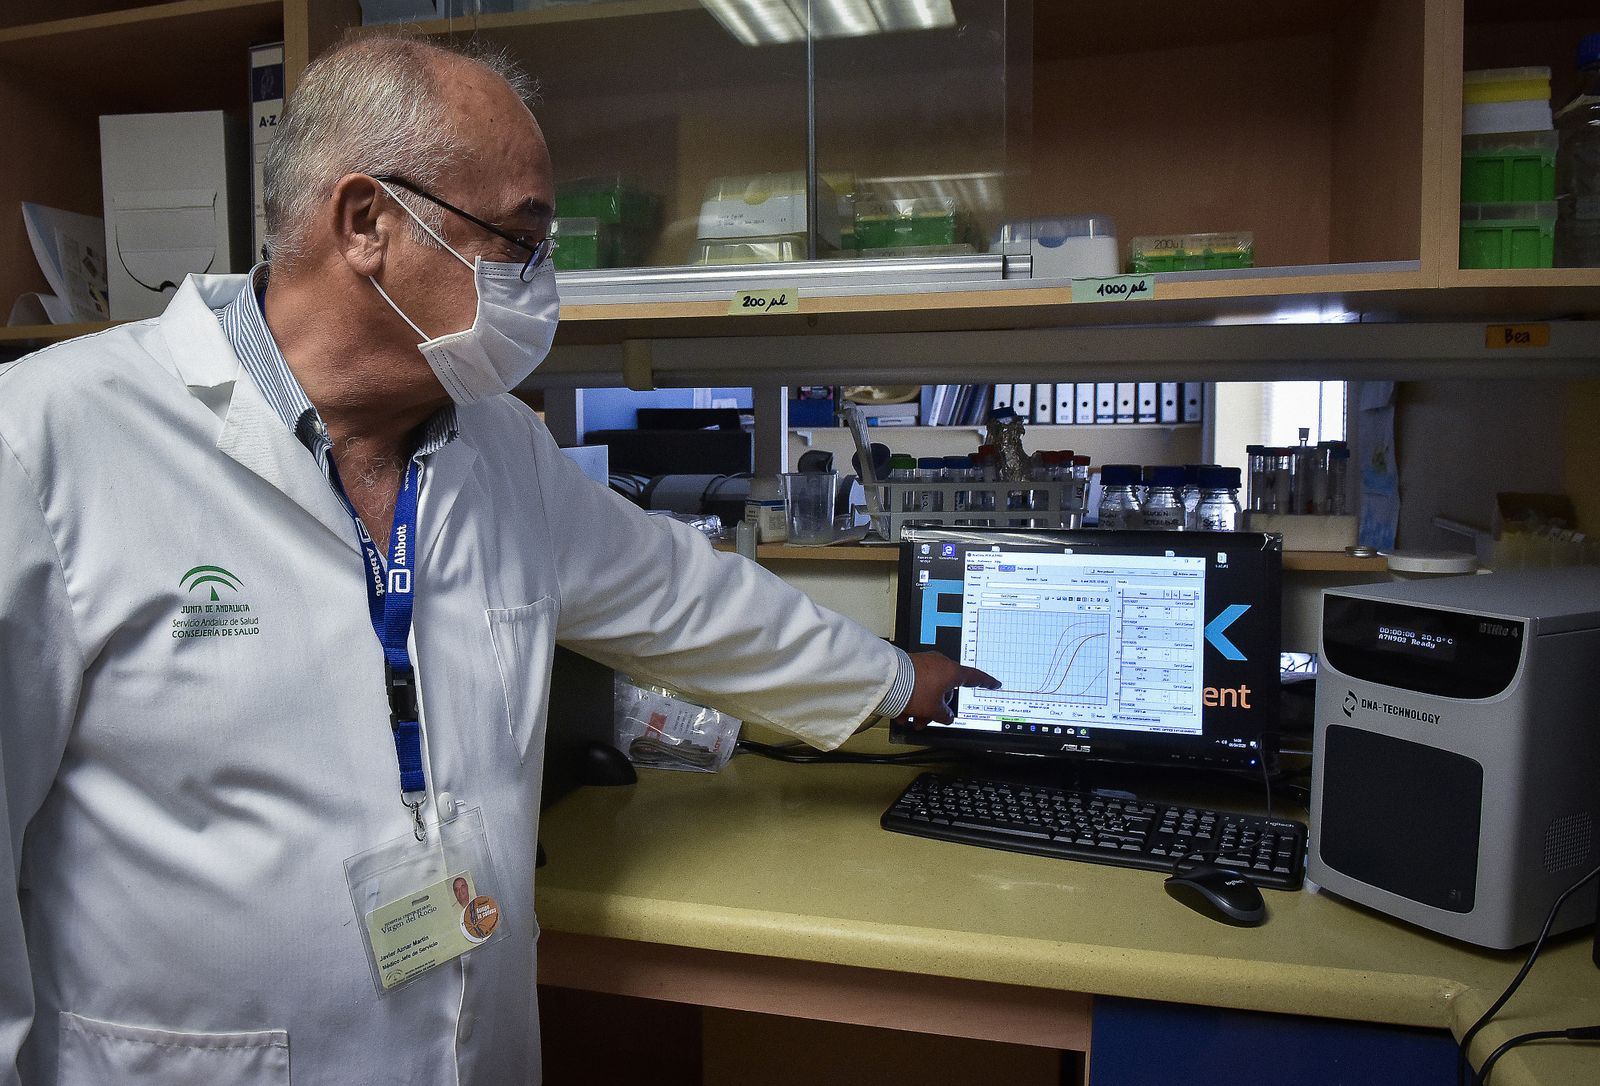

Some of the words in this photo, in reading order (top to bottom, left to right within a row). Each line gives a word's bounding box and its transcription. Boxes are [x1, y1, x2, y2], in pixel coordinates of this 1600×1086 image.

[1097, 284, 1127, 296] 1000
[742, 296, 766, 307] 200
[1505, 329, 1530, 344] Bea
[394, 524, 407, 566] Abbott
[366, 547, 385, 597] Abbott
[181, 605, 202, 614] JUNTA
[205, 605, 214, 613] DE
[172, 618, 200, 628] Servicio
[201, 618, 229, 627] Andaluz
[230, 618, 239, 626] de
[240, 617, 259, 625] Salud
[222, 628, 233, 636] DE
[234, 627, 260, 636] SALUD
[1379, 627, 1415, 638] 00:00:00
[1411, 638, 1436, 649] Ready
[1361, 699, 1440, 725] DNA-TECHNOLOGY
[1060, 743, 1091, 753] ASUS
[381, 921, 404, 934] Virgen
[405, 912, 417, 924] del
[418, 941, 439, 953] Servicio
[380, 950, 397, 962] Javier
